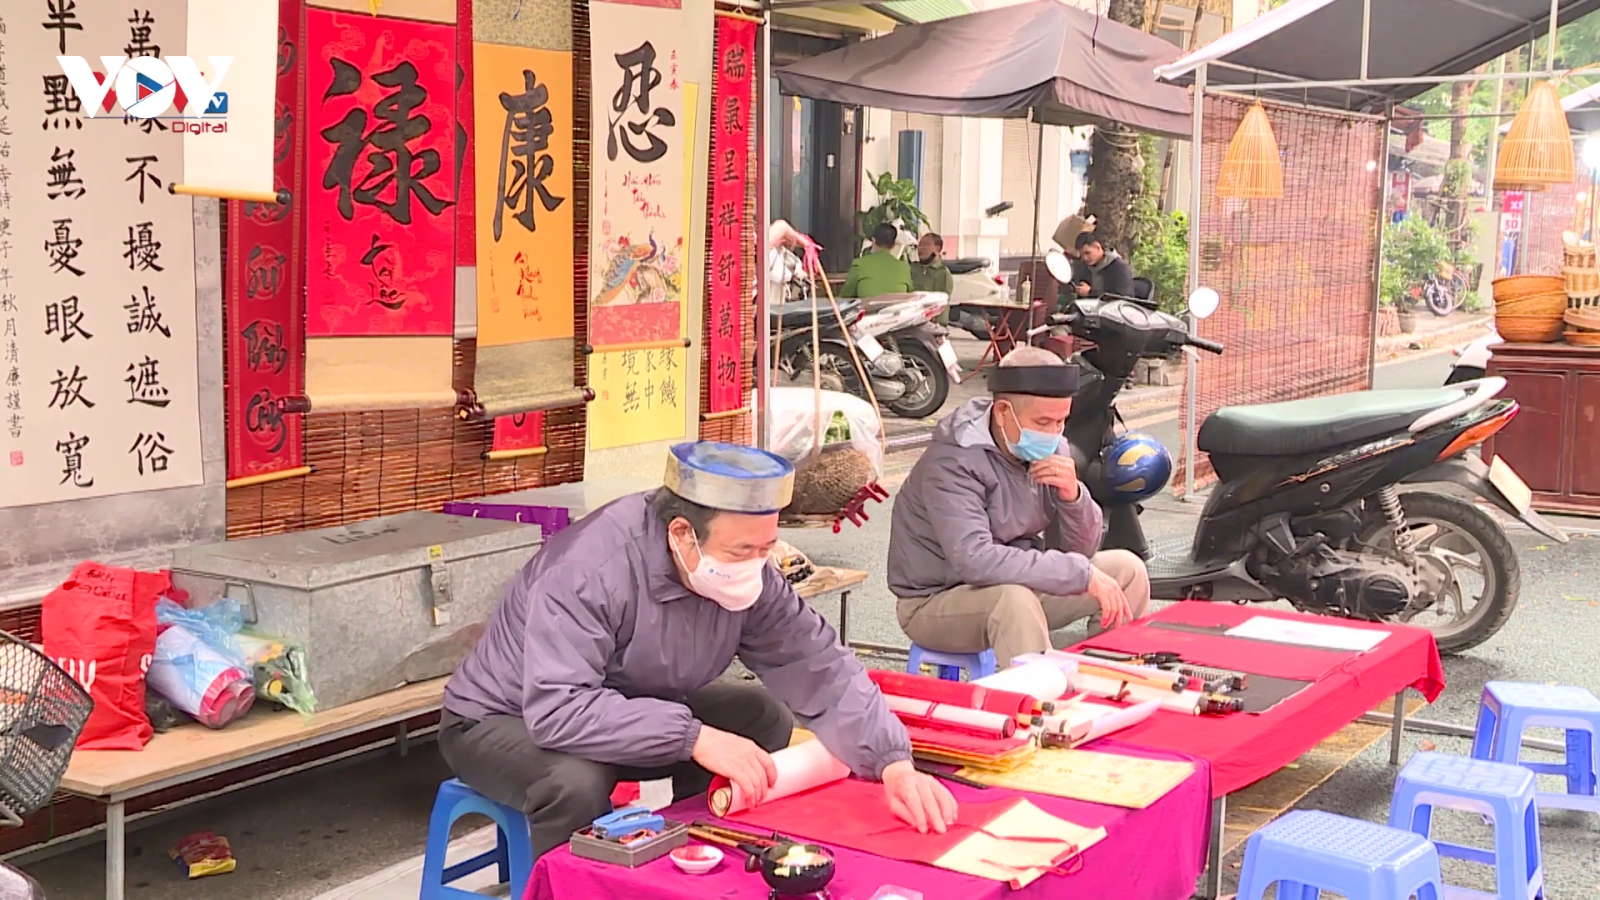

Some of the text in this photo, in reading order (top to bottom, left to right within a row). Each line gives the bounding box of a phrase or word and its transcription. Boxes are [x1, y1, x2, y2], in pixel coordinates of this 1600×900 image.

[122, 8, 176, 476] 萬不擾誠遮俗
[493, 69, 566, 243] 康
